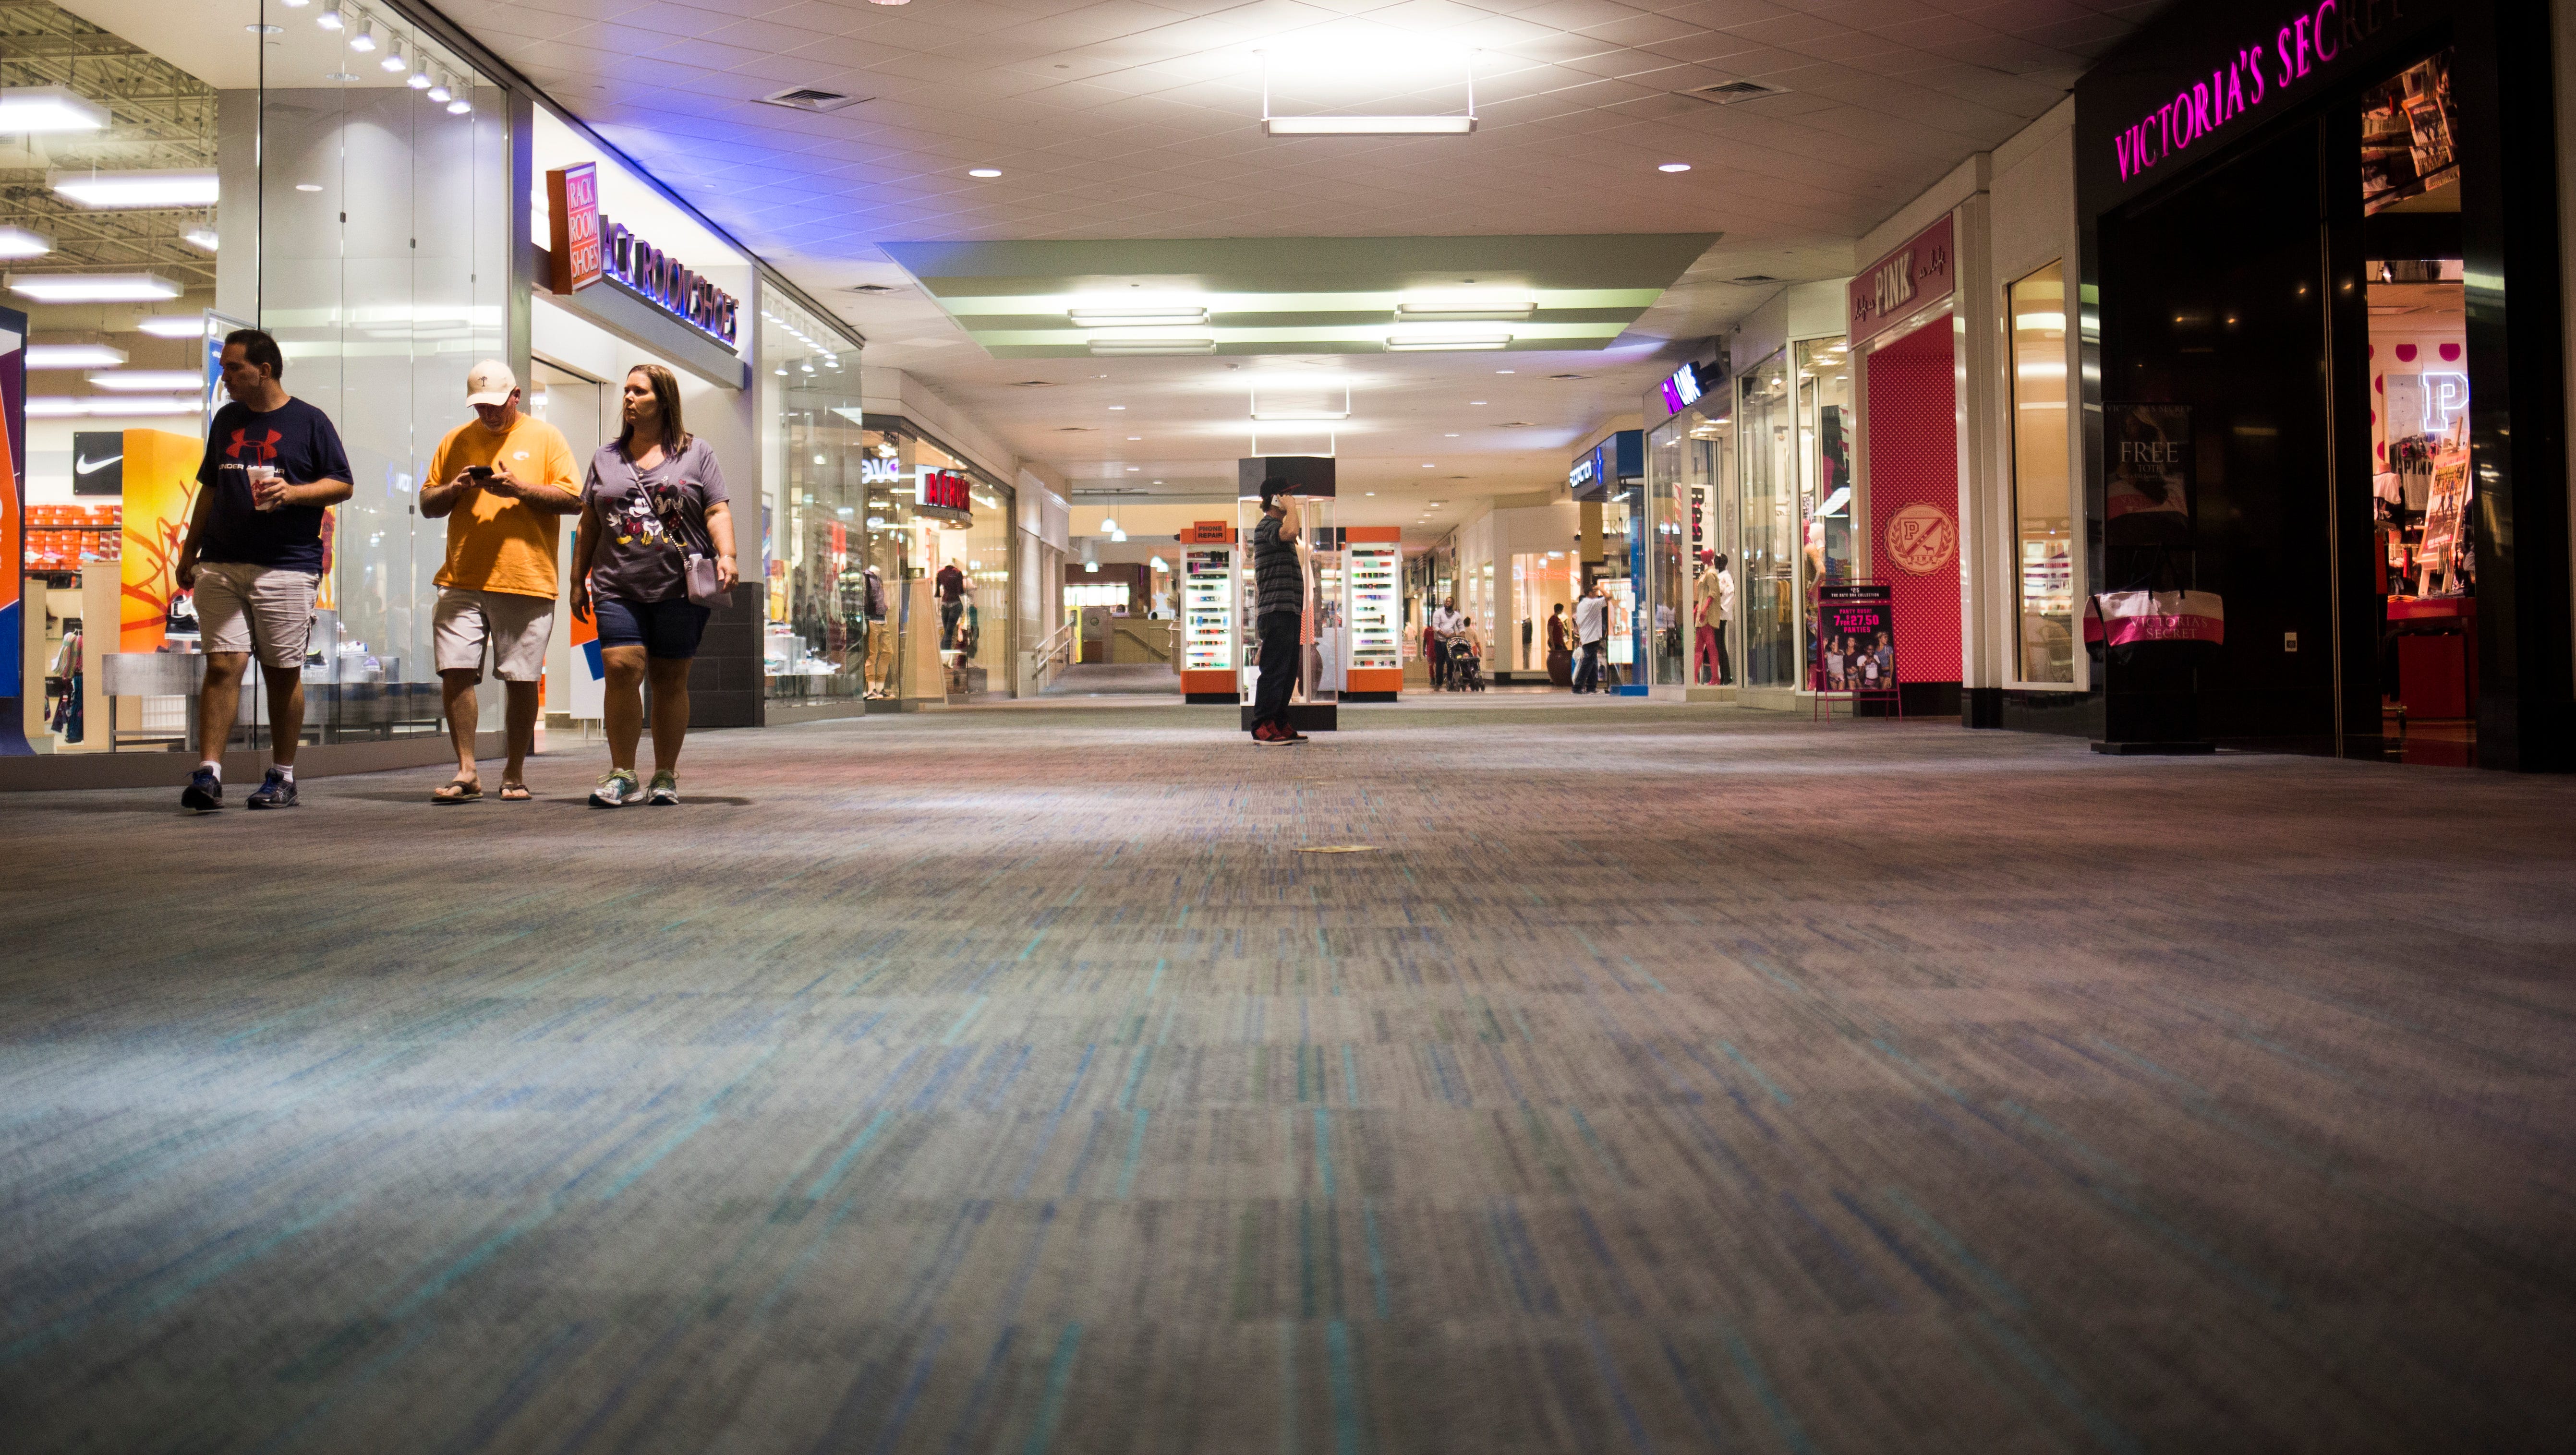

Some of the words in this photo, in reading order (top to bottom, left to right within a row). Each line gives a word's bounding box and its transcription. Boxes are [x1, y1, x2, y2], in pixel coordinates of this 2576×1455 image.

[2115, 46, 2264, 183] VICTORIA'S
[569, 178, 593, 210] RACK
[570, 212, 597, 243] ROOM
[571, 244, 599, 278] SHOES
[600, 215, 637, 288] ACK
[636, 240, 693, 319] ROOM
[694, 275, 739, 346] SHOES
[1875, 251, 1913, 315] PINK
[2422, 372, 2470, 432] P
[2120, 441, 2179, 463] FREE
[2404, 460, 2434, 475] PINK
[1904, 521, 1919, 540] P
[1833, 615, 1840, 626] 7
[2146, 628, 2199, 639] SECRET
